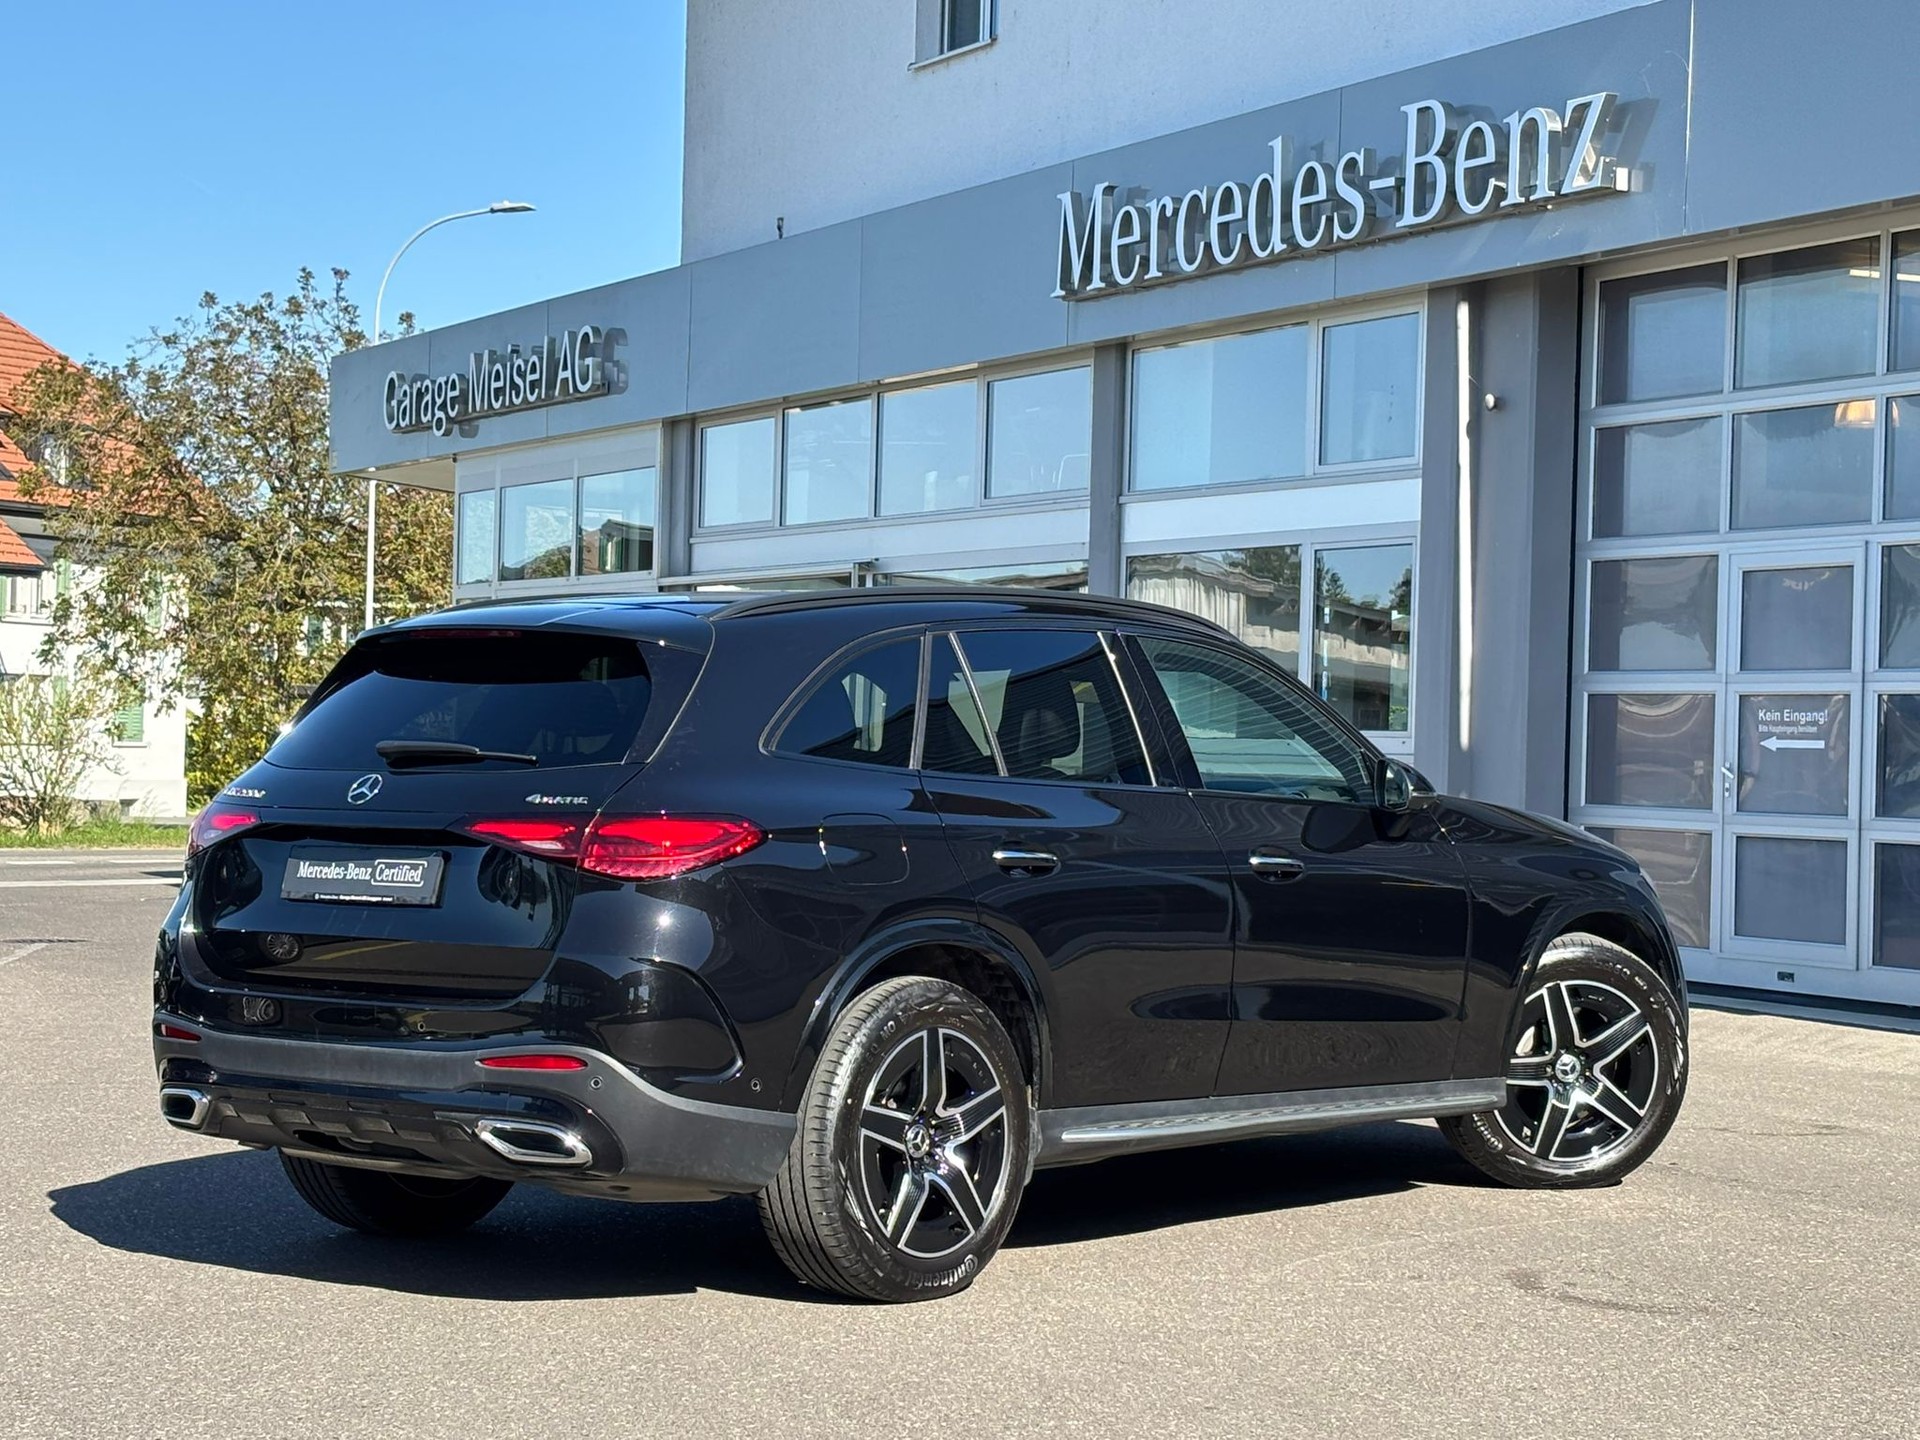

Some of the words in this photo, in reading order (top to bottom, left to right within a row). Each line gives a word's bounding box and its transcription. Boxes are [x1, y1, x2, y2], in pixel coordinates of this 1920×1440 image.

[1050, 92, 1618, 297] Mercedes-Benz
[383, 370, 460, 437] Garage
[468, 335, 548, 414] Meisel
[555, 324, 595, 397] AG
[1758, 709, 1781, 722] Kein
[1783, 709, 1828, 725] Eingang!
[297, 860, 373, 881] Mercedes-Benz
[375, 863, 423, 883] Certified
